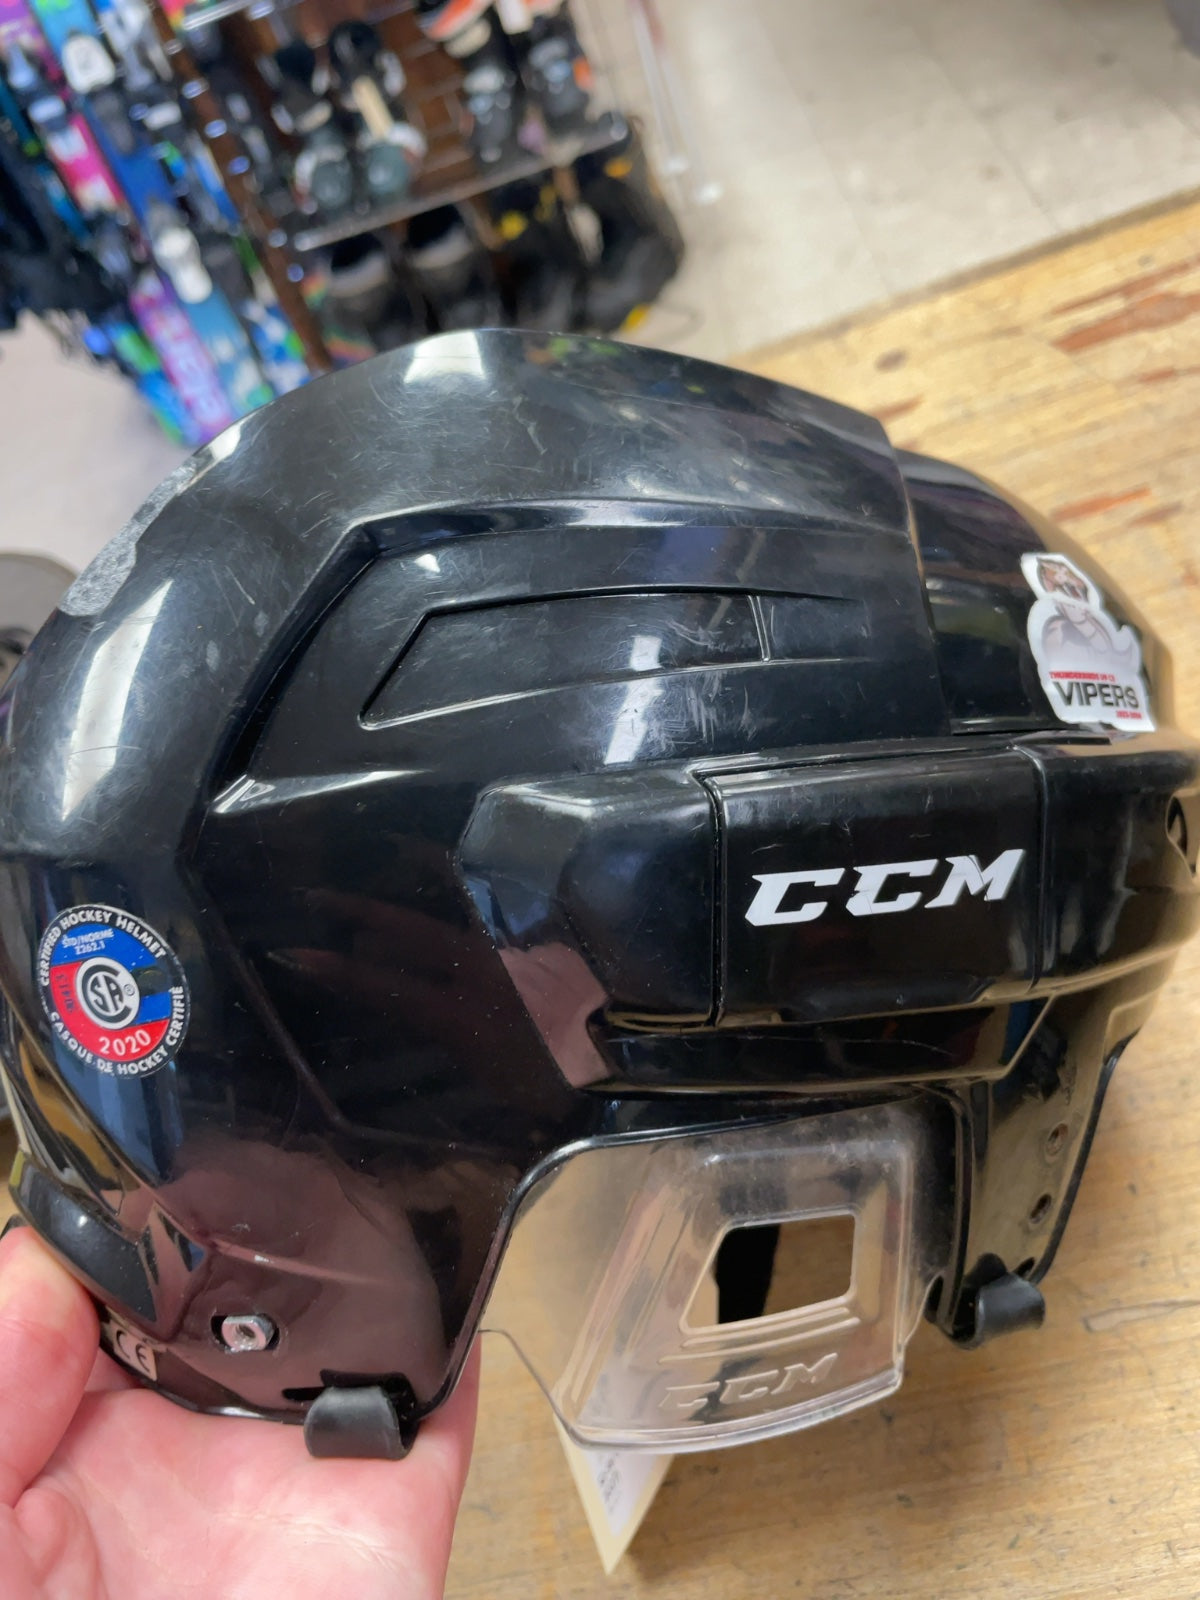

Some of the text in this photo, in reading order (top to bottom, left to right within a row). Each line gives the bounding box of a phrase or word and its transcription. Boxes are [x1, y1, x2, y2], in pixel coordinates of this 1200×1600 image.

[1053, 682, 1139, 709] VIPERS
[745, 849, 1024, 926] CCM
[40, 910, 167, 986] CERTIFIED HOCKEY HELMET
[50, 1011, 94, 1064] CASQUE
[97, 1060, 114, 1073] DE
[117, 1046, 169, 1075] HOCKEY
[99, 1029, 151, 1056] 2020
[659, 1352, 838, 1408] CCM
